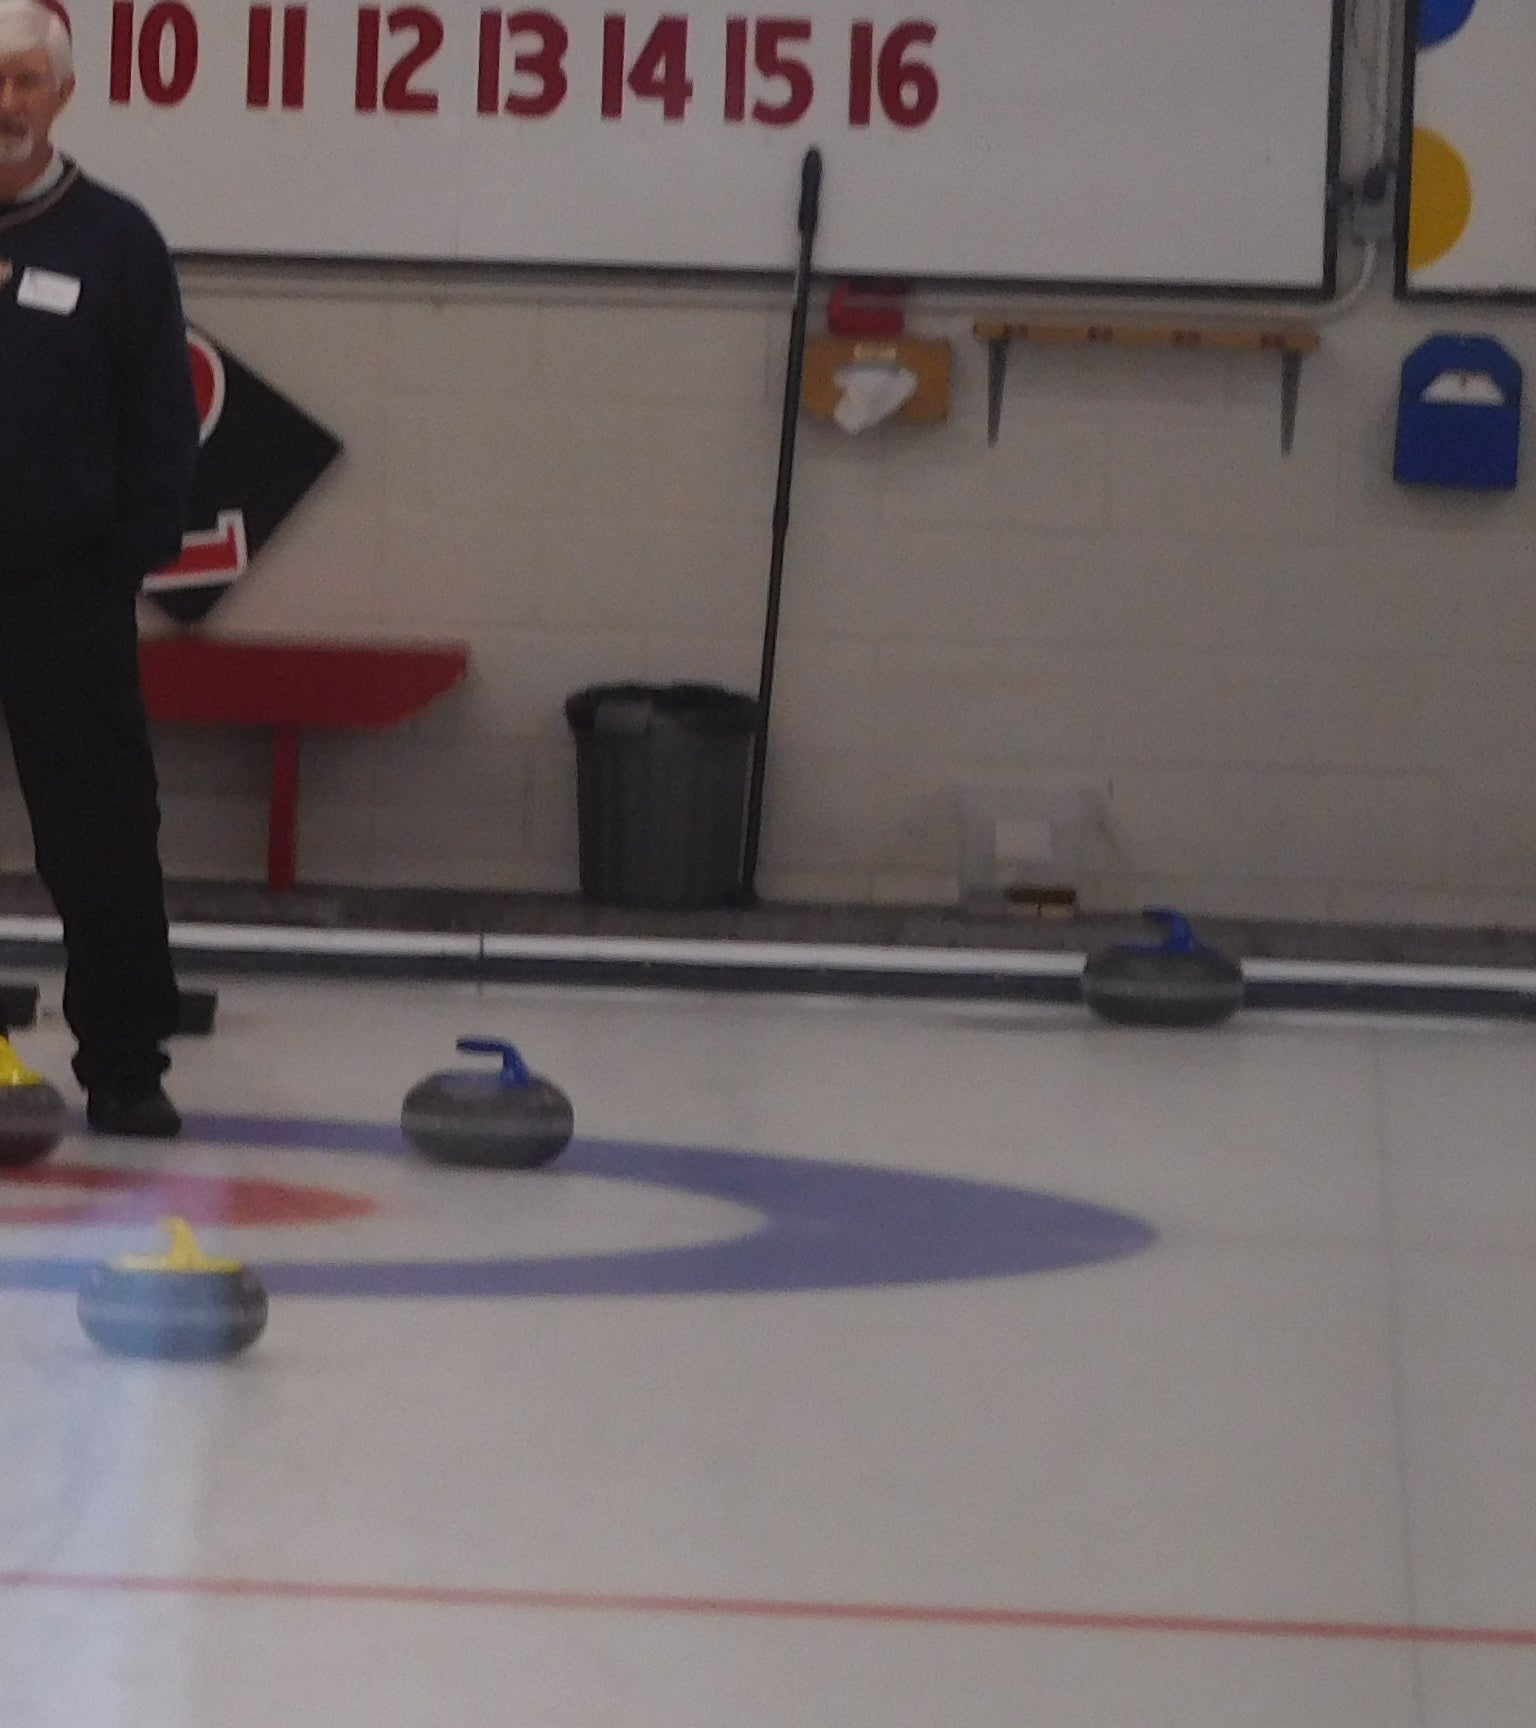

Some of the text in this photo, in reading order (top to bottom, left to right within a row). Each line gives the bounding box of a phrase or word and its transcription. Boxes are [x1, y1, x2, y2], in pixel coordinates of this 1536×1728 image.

[109, 0, 201, 106] 10
[246, 5, 307, 110] 11
[355, 7, 445, 115] 12
[478, 11, 569, 117] 13
[602, 15, 693, 121] 14
[725, 19, 815, 125] 15
[848, 22, 939, 127] 16
